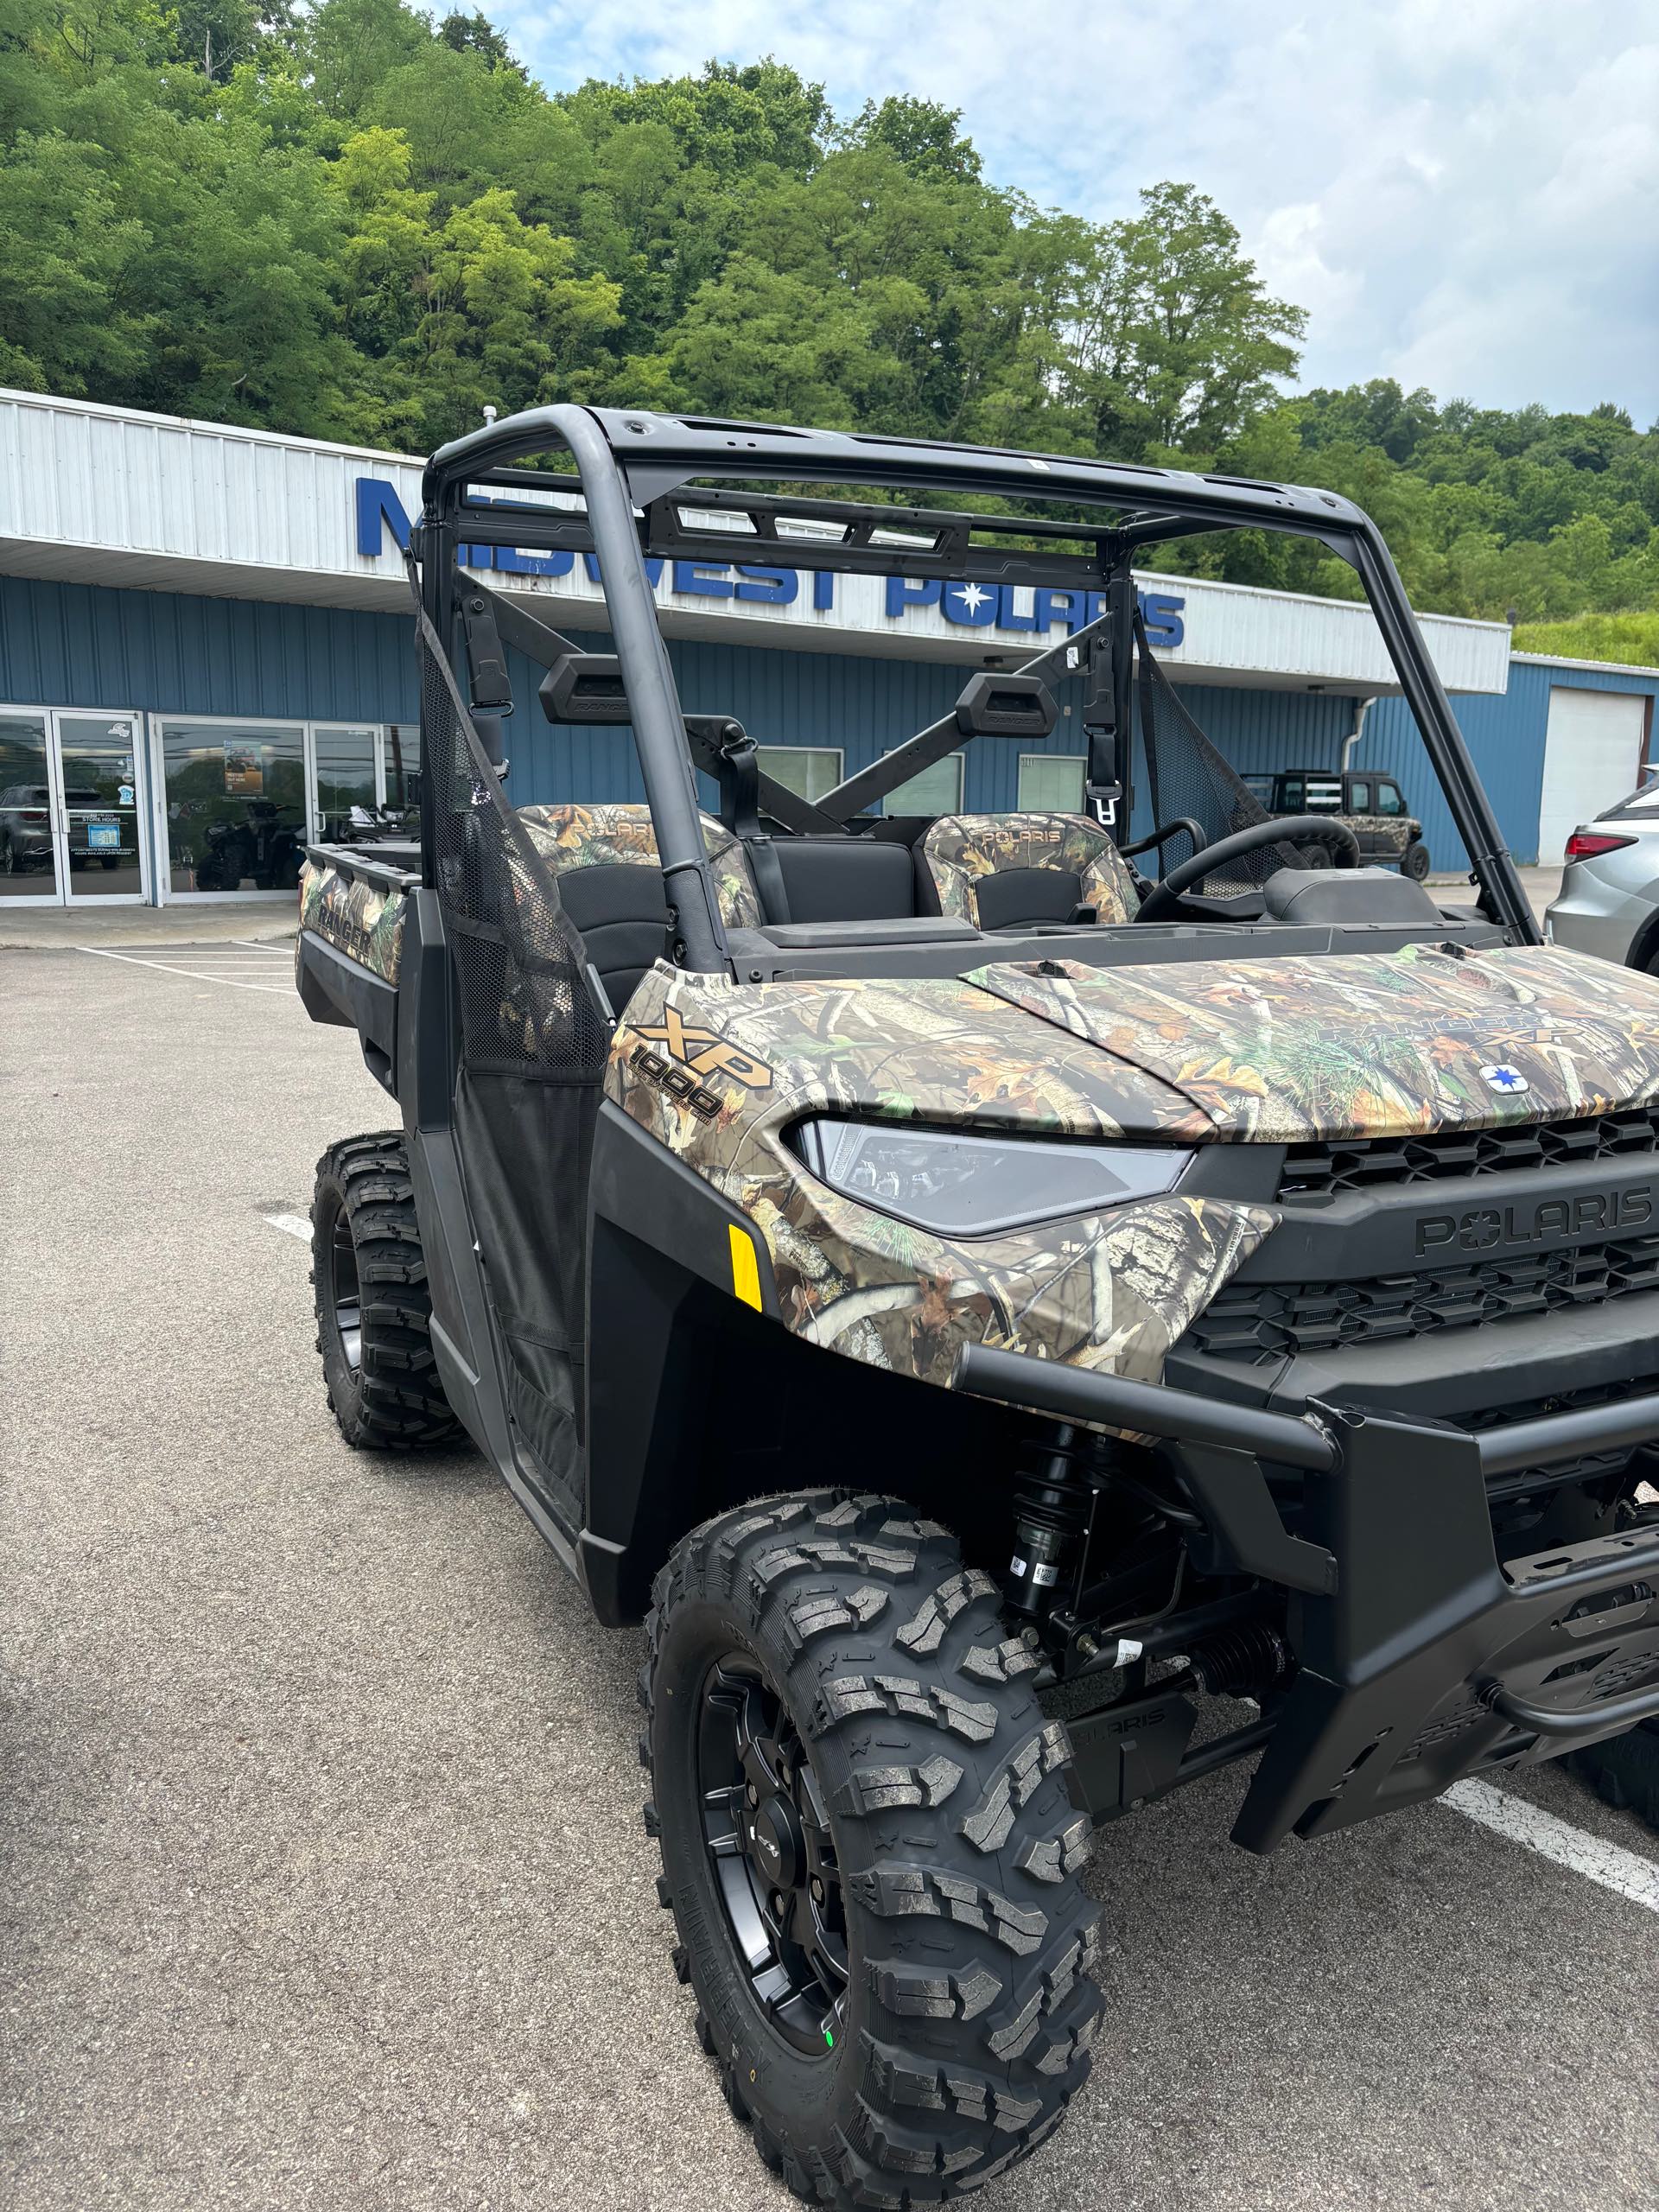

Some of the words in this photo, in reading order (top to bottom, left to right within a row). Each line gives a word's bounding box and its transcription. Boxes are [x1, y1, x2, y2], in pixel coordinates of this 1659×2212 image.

[356, 477, 833, 610] MIDES
[885, 575, 1185, 647] POLAS
[574, 703, 629, 712] RANGE
[570, 823, 654, 836] POLARI
[981, 830, 1062, 844] POLARIS
[318, 904, 372, 958] RANGER
[625, 1001, 774, 1091] XP
[1315, 1014, 1545, 1042] RANGER
[1466, 1026, 1586, 1049] XP
[626, 1063, 649, 1084] DUAL
[647, 1077, 692, 1111] OVERHEAD
[690, 1108, 713, 1127] CAM
[629, 1042, 725, 1119] 1000
[1414, 1186, 1652, 1258] POLARIS
